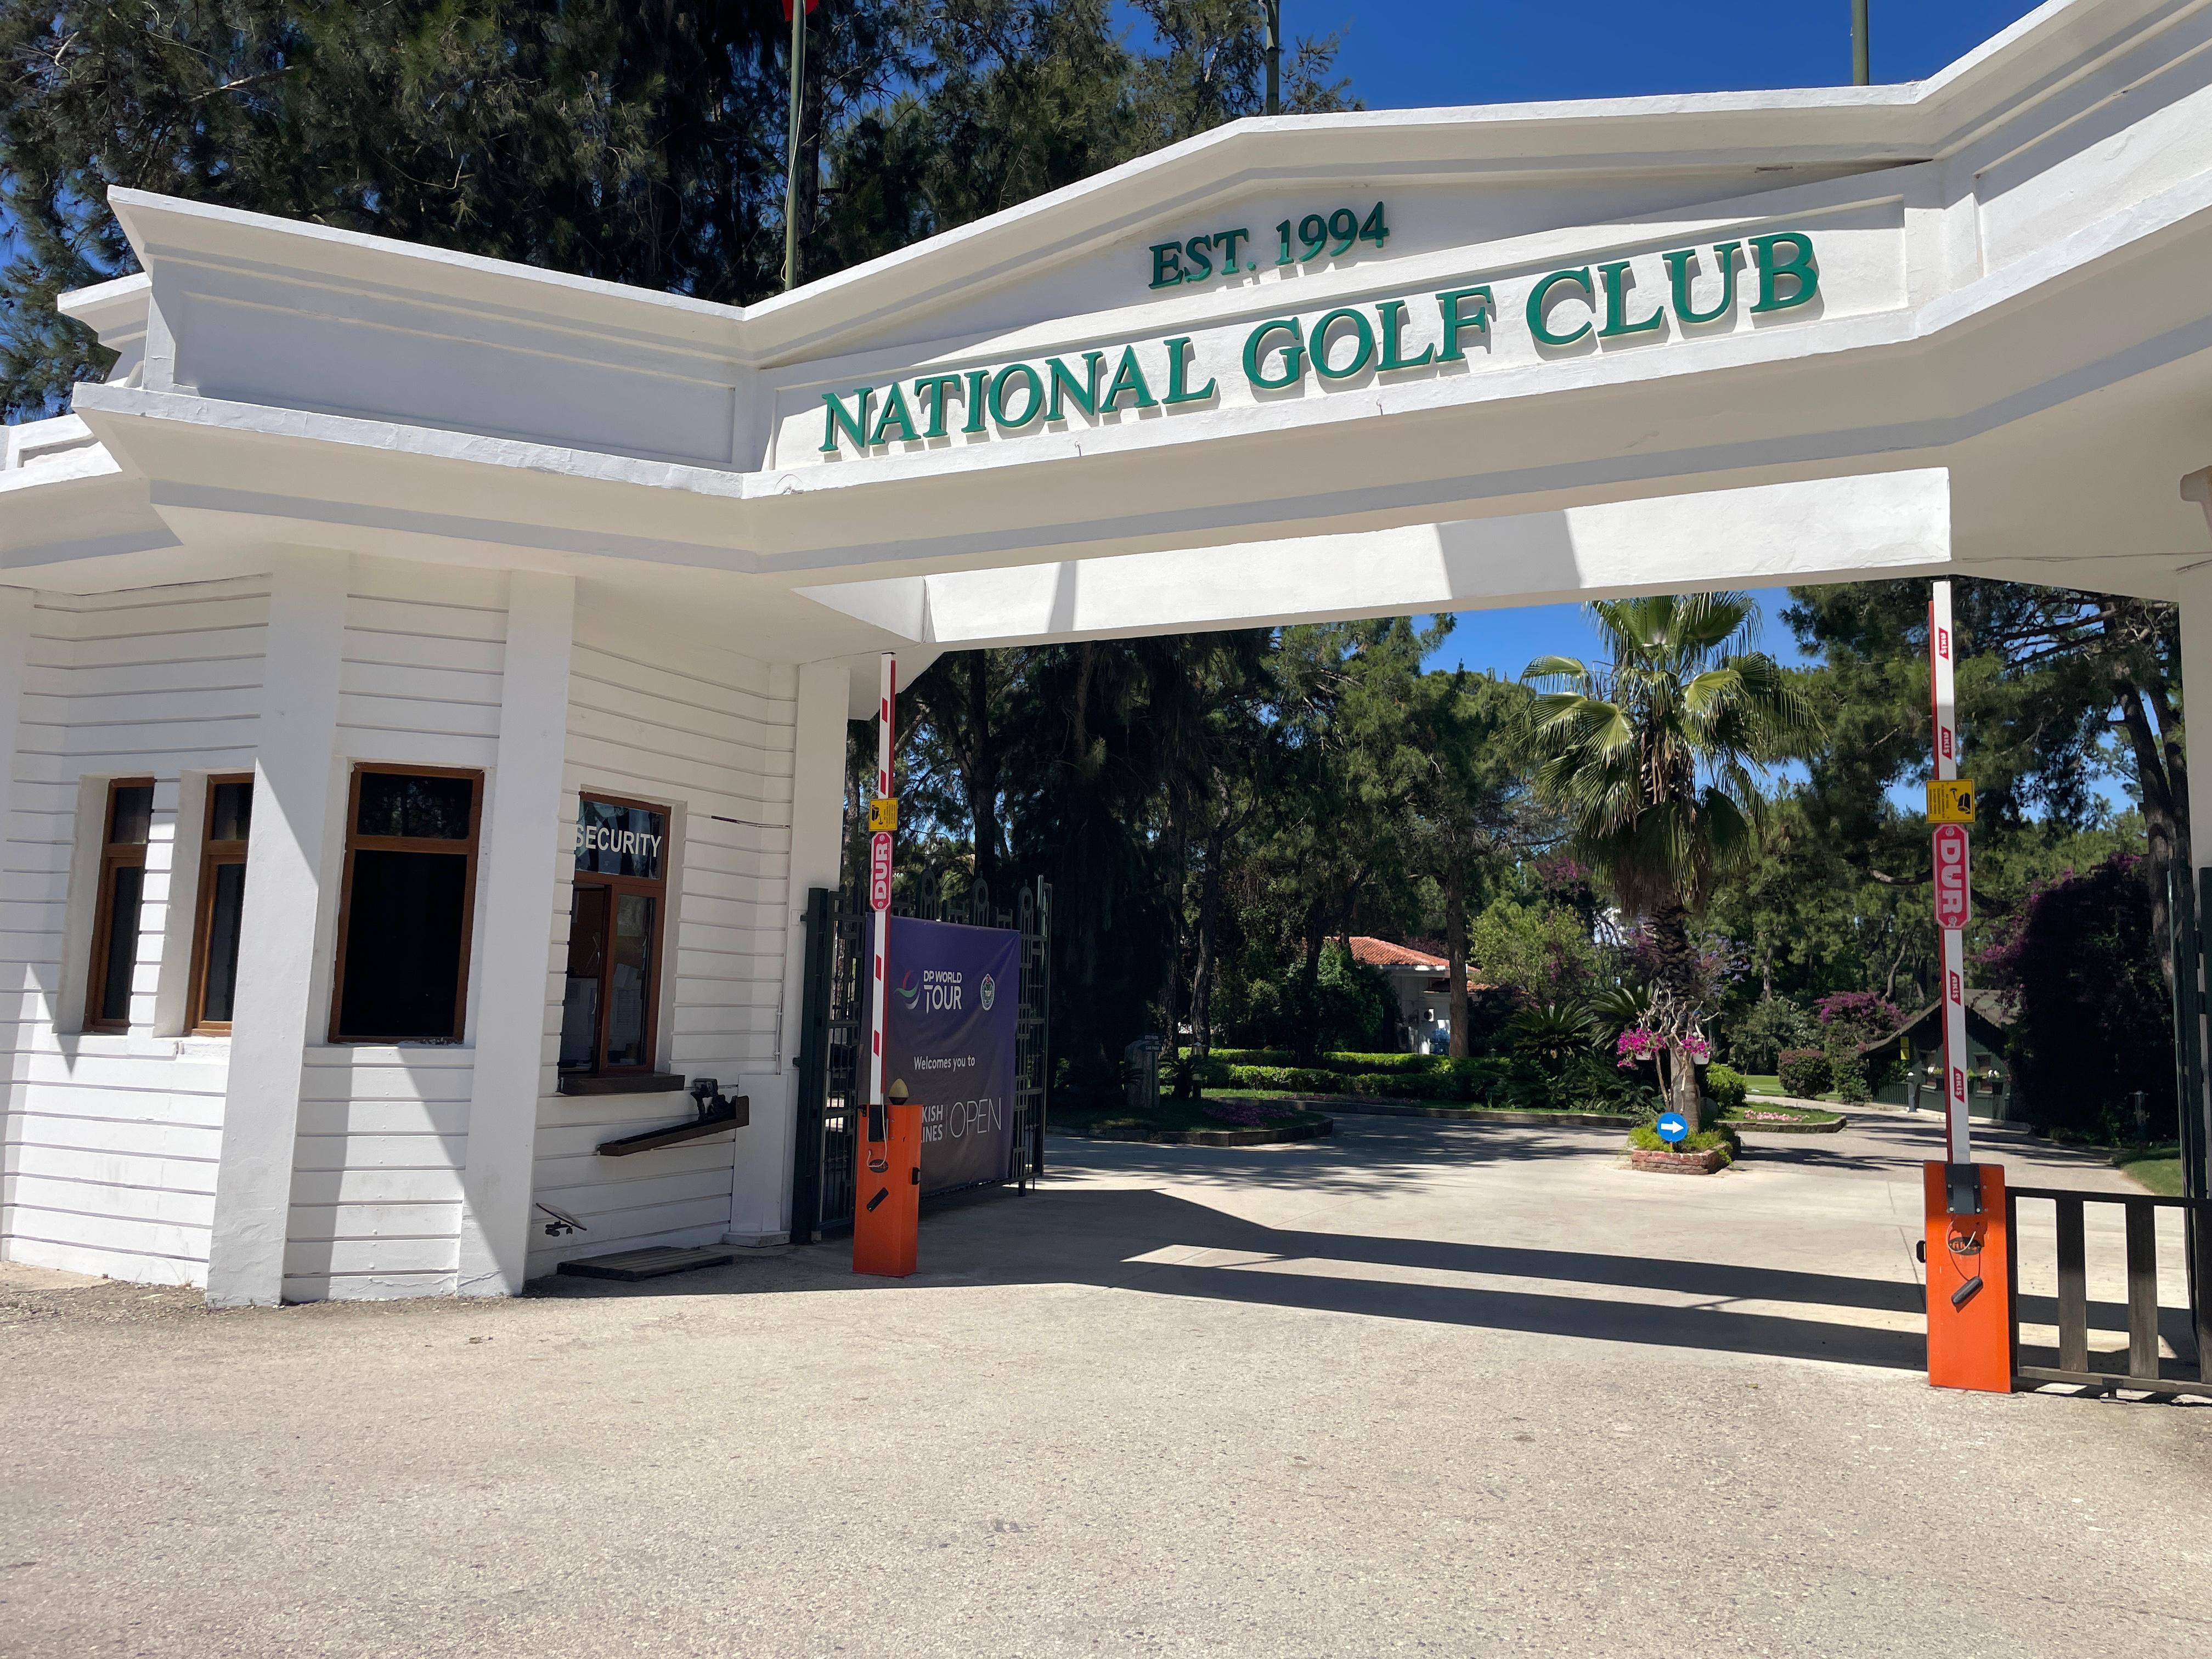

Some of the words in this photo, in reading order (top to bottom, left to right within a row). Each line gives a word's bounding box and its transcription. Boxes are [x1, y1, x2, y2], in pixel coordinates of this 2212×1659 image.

[1149, 228, 1257, 289] EST.
[1276, 201, 1389, 266] 1994
[819, 336, 1216, 452] NATIONAL
[1243, 285, 1492, 390] GOLF
[1526, 232, 1819, 345] CLUB
[576, 825, 662, 857] SECURITY
[874, 843, 888, 899] DUR
[1940, 839, 1962, 913] DUR
[923, 970, 935, 982] DP
[935, 970, 962, 983] WORLD
[923, 984, 962, 1014] TOUR
[913, 1056, 951, 1070] Welcomes
[953, 1057, 966, 1072] you
[967, 1054, 975, 1066] to
[922, 1104, 943, 1123] KISH
[950, 1097, 1001, 1138] OPEN
[921, 1124, 943, 1143] INES
